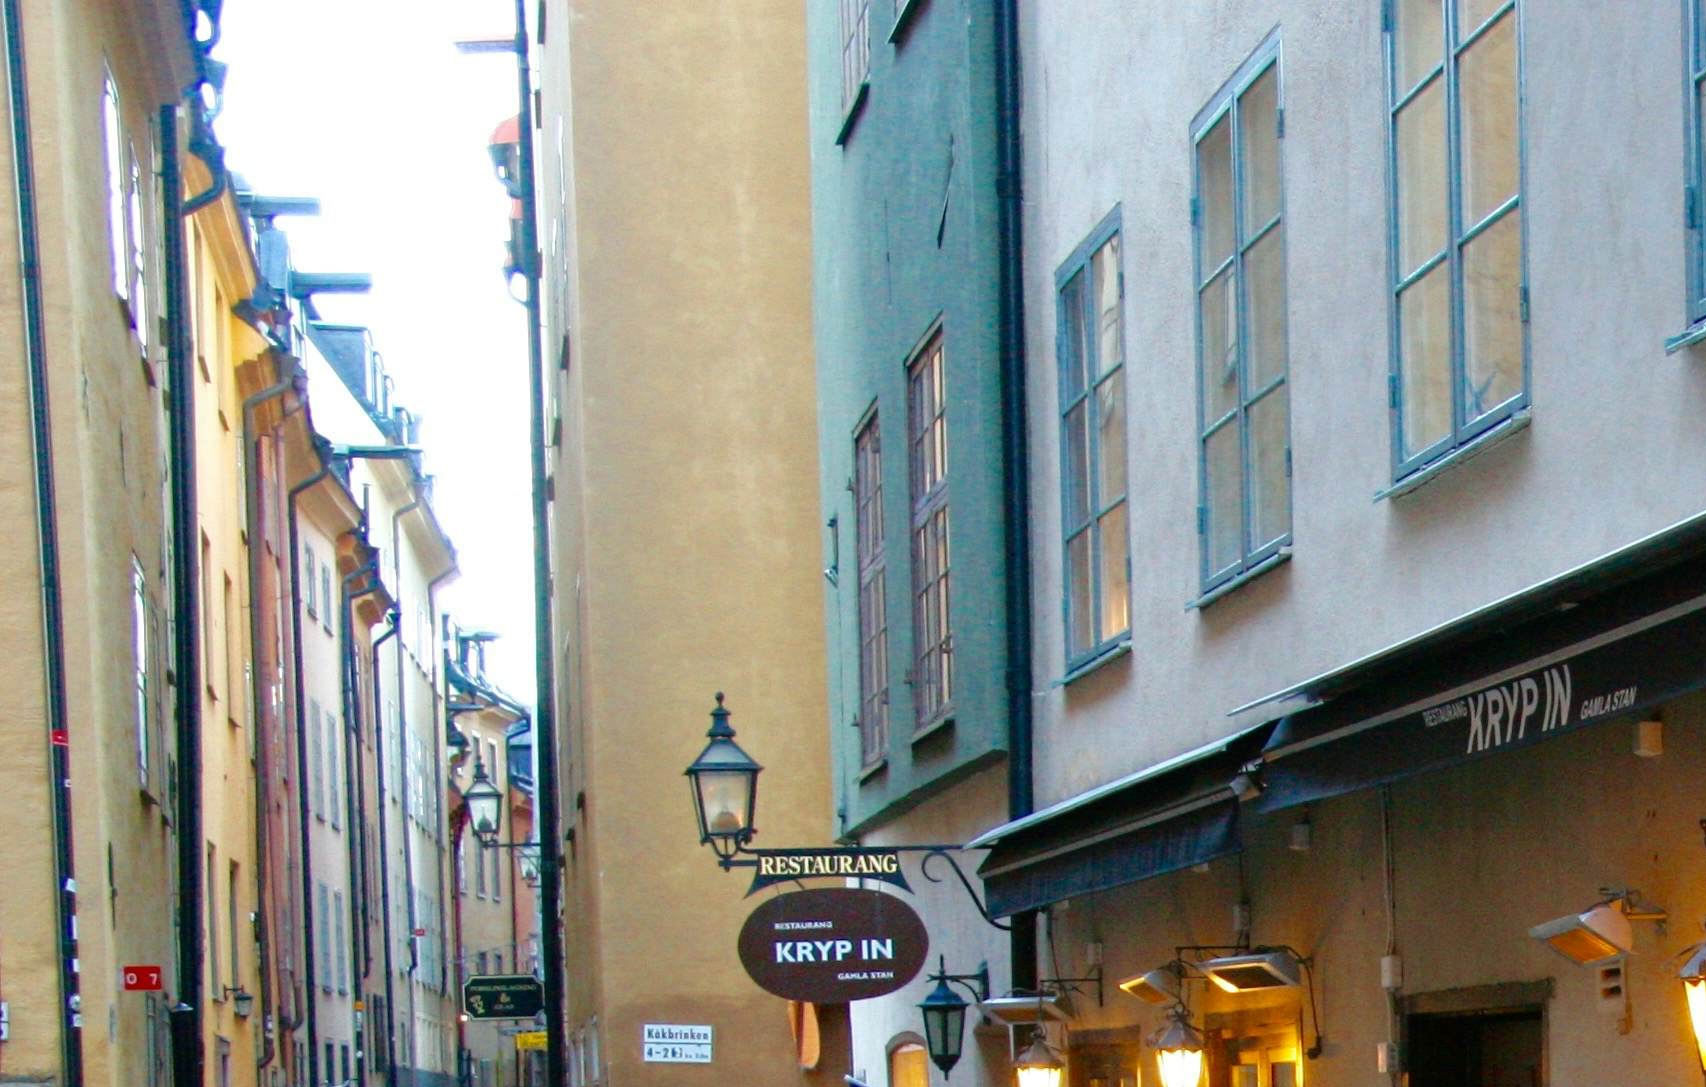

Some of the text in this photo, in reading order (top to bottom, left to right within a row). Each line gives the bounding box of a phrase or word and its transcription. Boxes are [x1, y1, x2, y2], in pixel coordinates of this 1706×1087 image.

[1466, 664, 1572, 754] KRYP IN
[1580, 687, 1637, 720] GAMLA STAN
[760, 854, 898, 875] RESTAURANG
[774, 921, 833, 930] RESTAURANG
[775, 938, 893, 963] KRYP IN
[837, 970, 894, 980] GAMLA STAN
